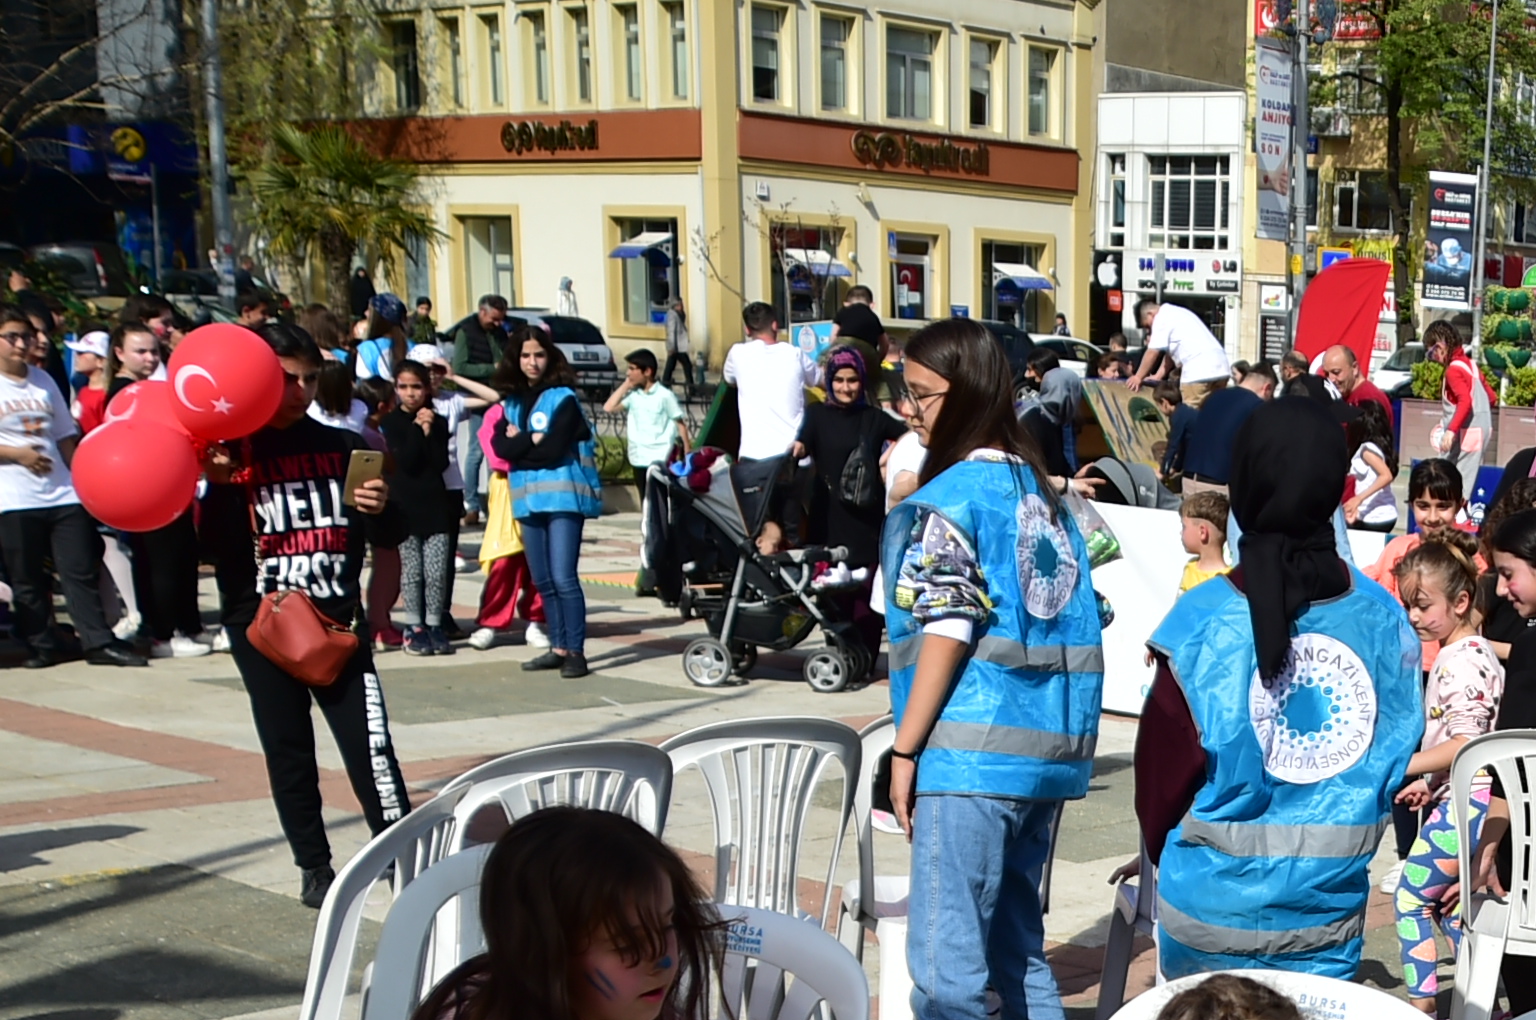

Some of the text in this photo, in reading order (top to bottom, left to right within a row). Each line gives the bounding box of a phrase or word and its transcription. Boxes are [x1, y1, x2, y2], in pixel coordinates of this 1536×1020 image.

[1138, 257, 1195, 272] SASUNG
[252, 478, 349, 534] WELL
[255, 552, 346, 598] FIRST
[727, 923, 763, 937] URSA
[1299, 993, 1347, 1011] BURSA
